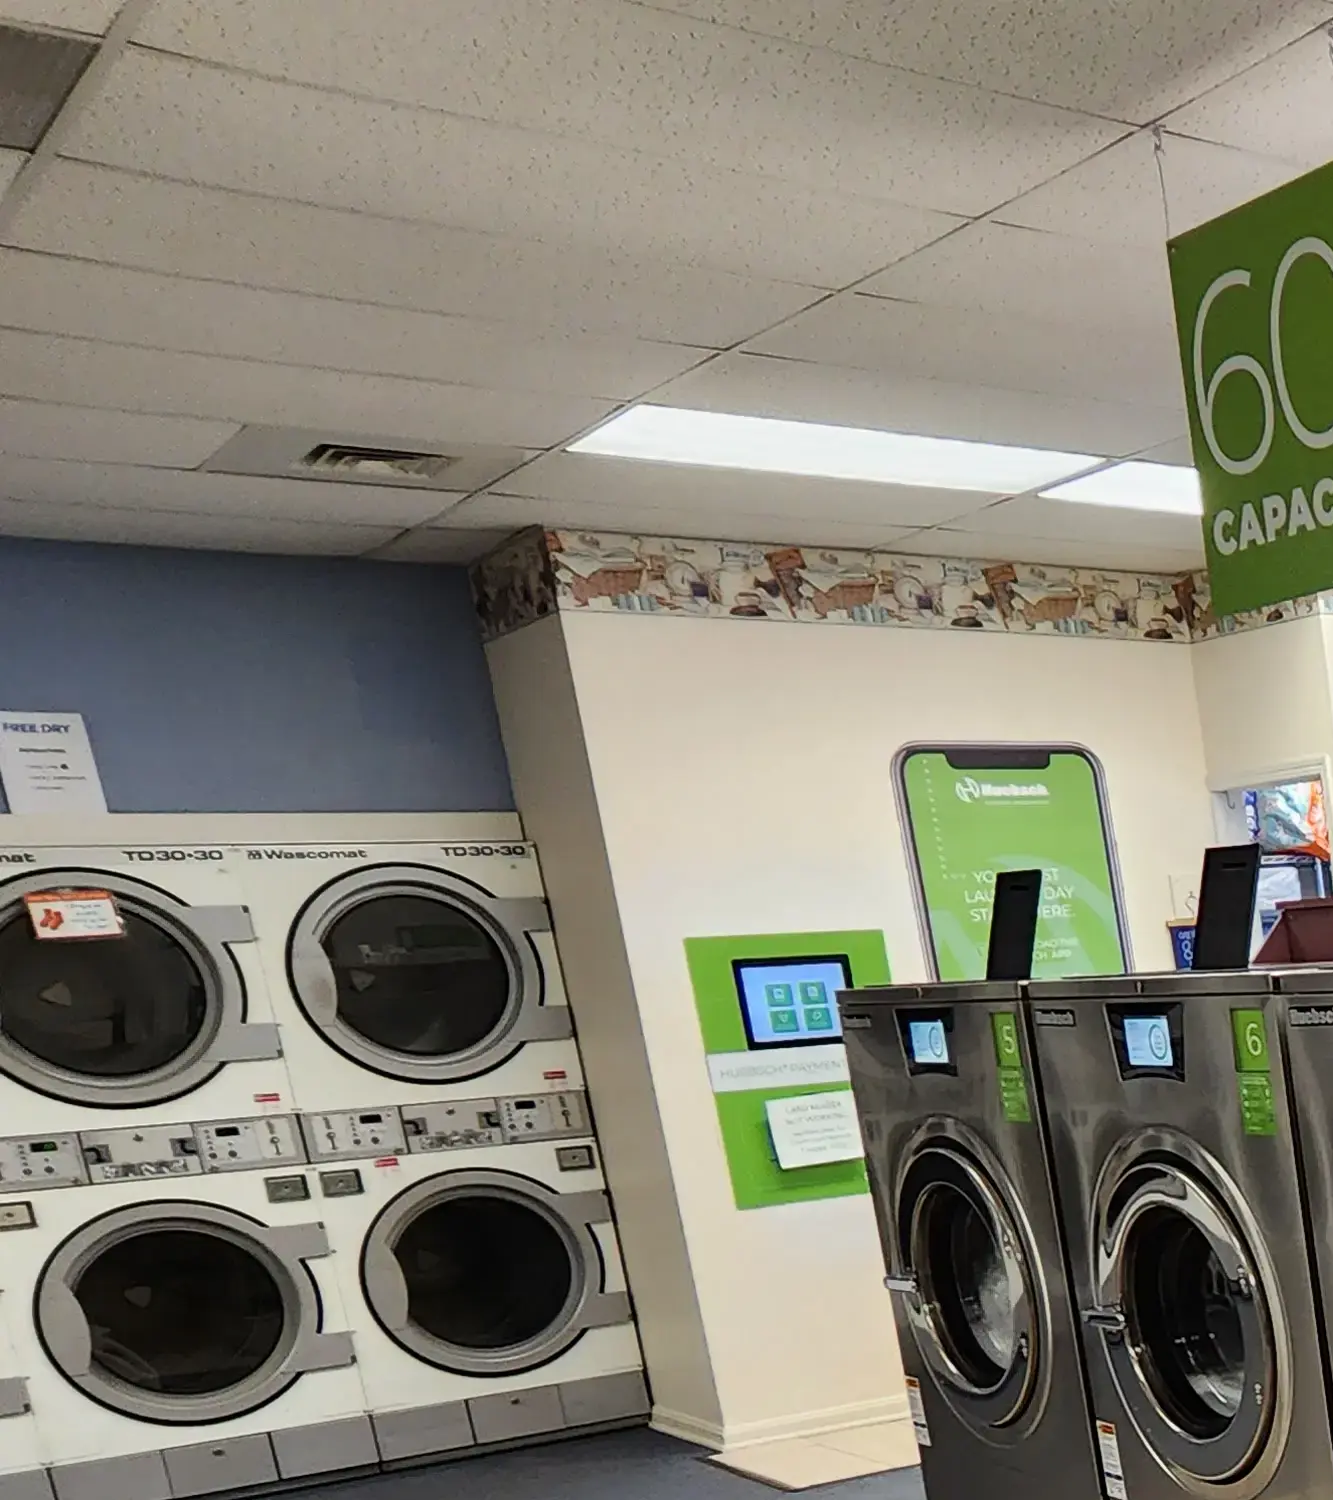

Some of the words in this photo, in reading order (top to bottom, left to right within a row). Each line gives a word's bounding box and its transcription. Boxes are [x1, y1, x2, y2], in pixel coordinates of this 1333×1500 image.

[41, 723, 70, 733] DRY
[262, 848, 368, 860] Wascomat
[1038, 904, 1076, 919] ERE.
[1002, 1025, 1017, 1054] 5
[1246, 1022, 1263, 1056] 6
